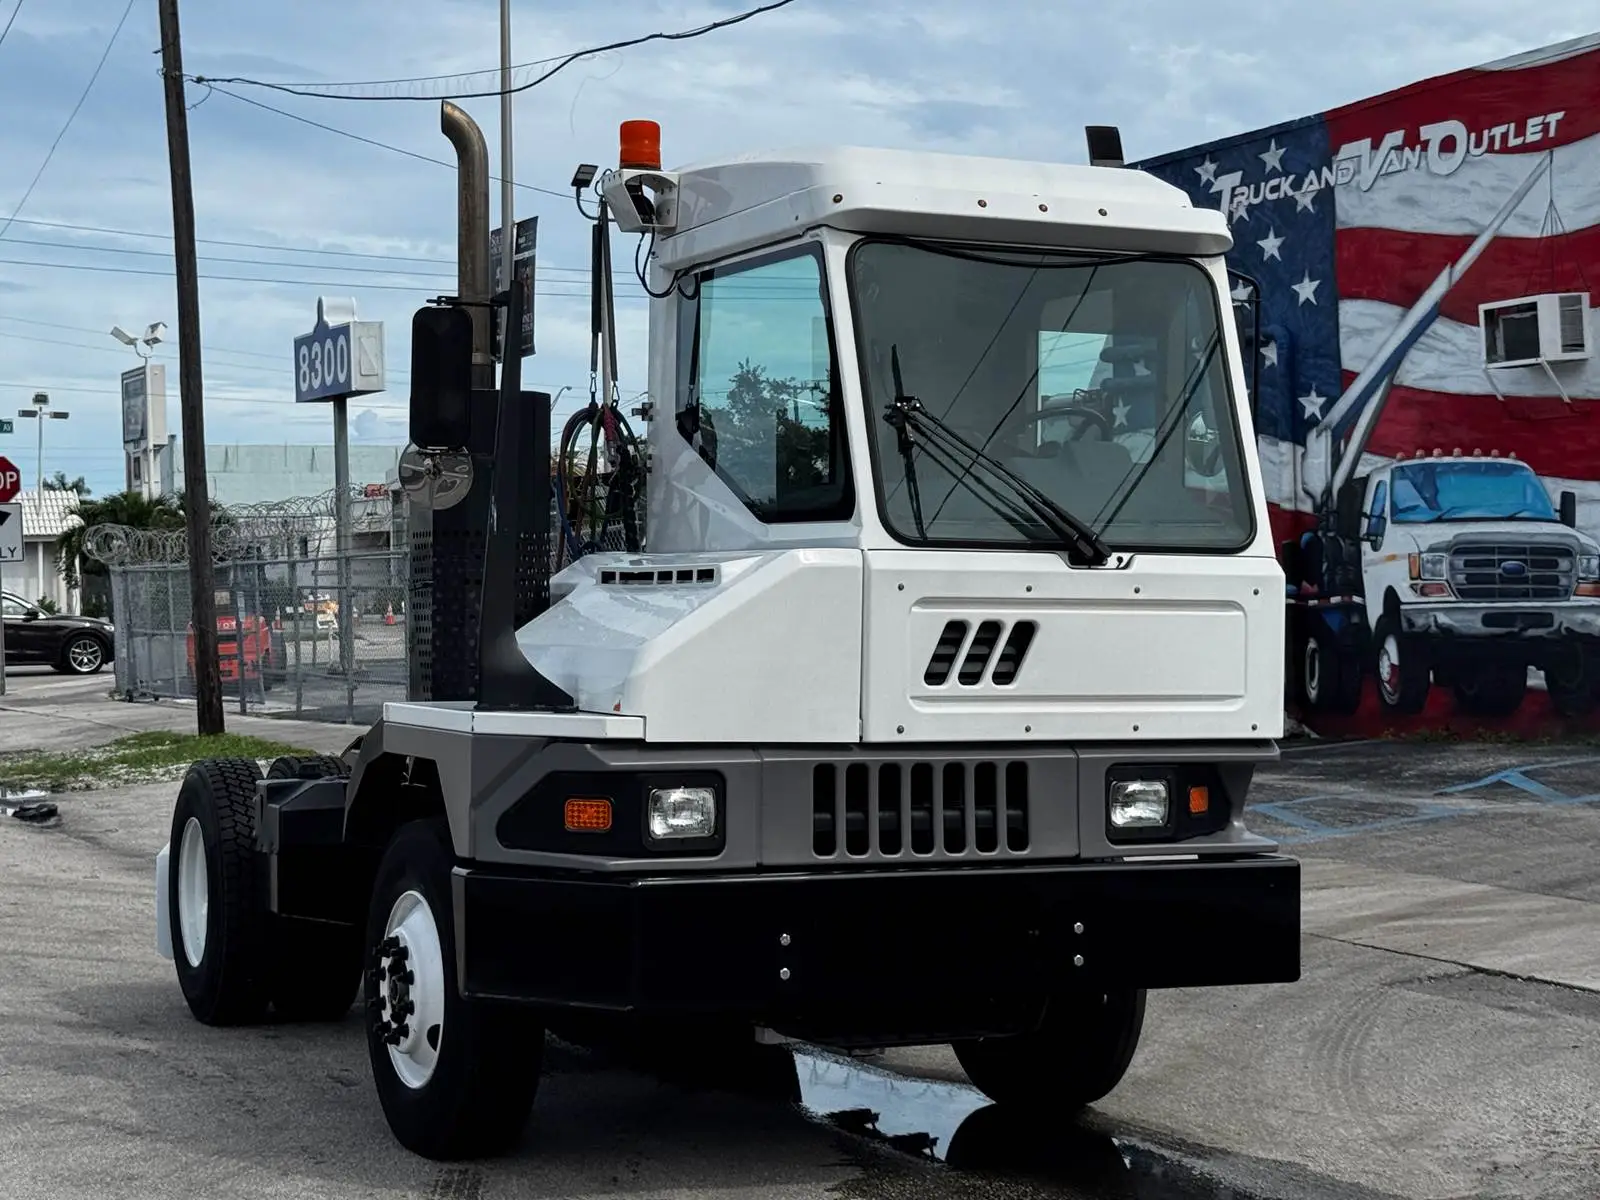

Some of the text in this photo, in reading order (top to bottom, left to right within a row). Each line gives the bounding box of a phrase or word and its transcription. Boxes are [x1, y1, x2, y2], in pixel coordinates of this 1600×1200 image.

[1208, 110, 1567, 220] TRUCK AND VAN OUTLET
[299, 333, 348, 392] 8300
